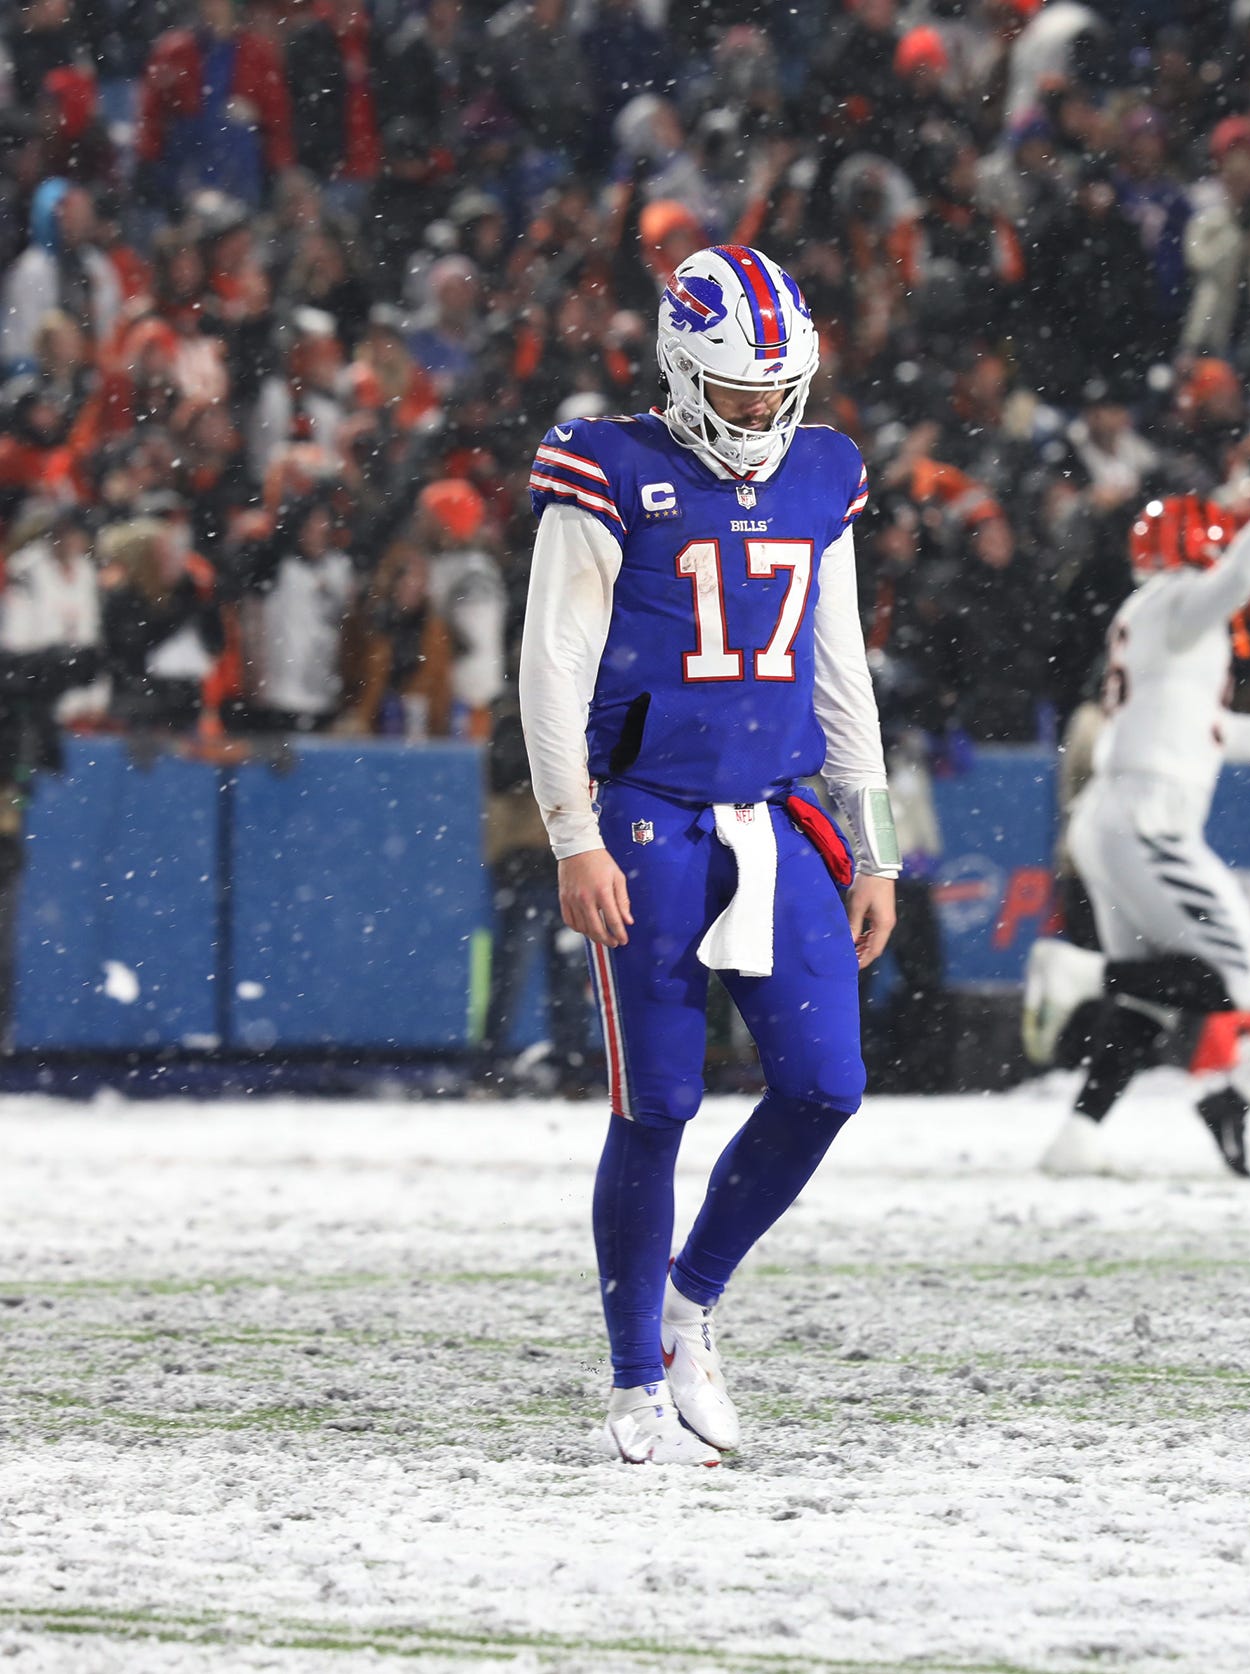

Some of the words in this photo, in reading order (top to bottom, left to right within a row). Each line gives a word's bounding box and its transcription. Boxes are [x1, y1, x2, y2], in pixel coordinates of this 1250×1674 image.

[641, 482, 676, 512] C
[730, 520, 768, 532] BILLS
[675, 537, 814, 683] 17
[735, 810, 753, 823] NFL
